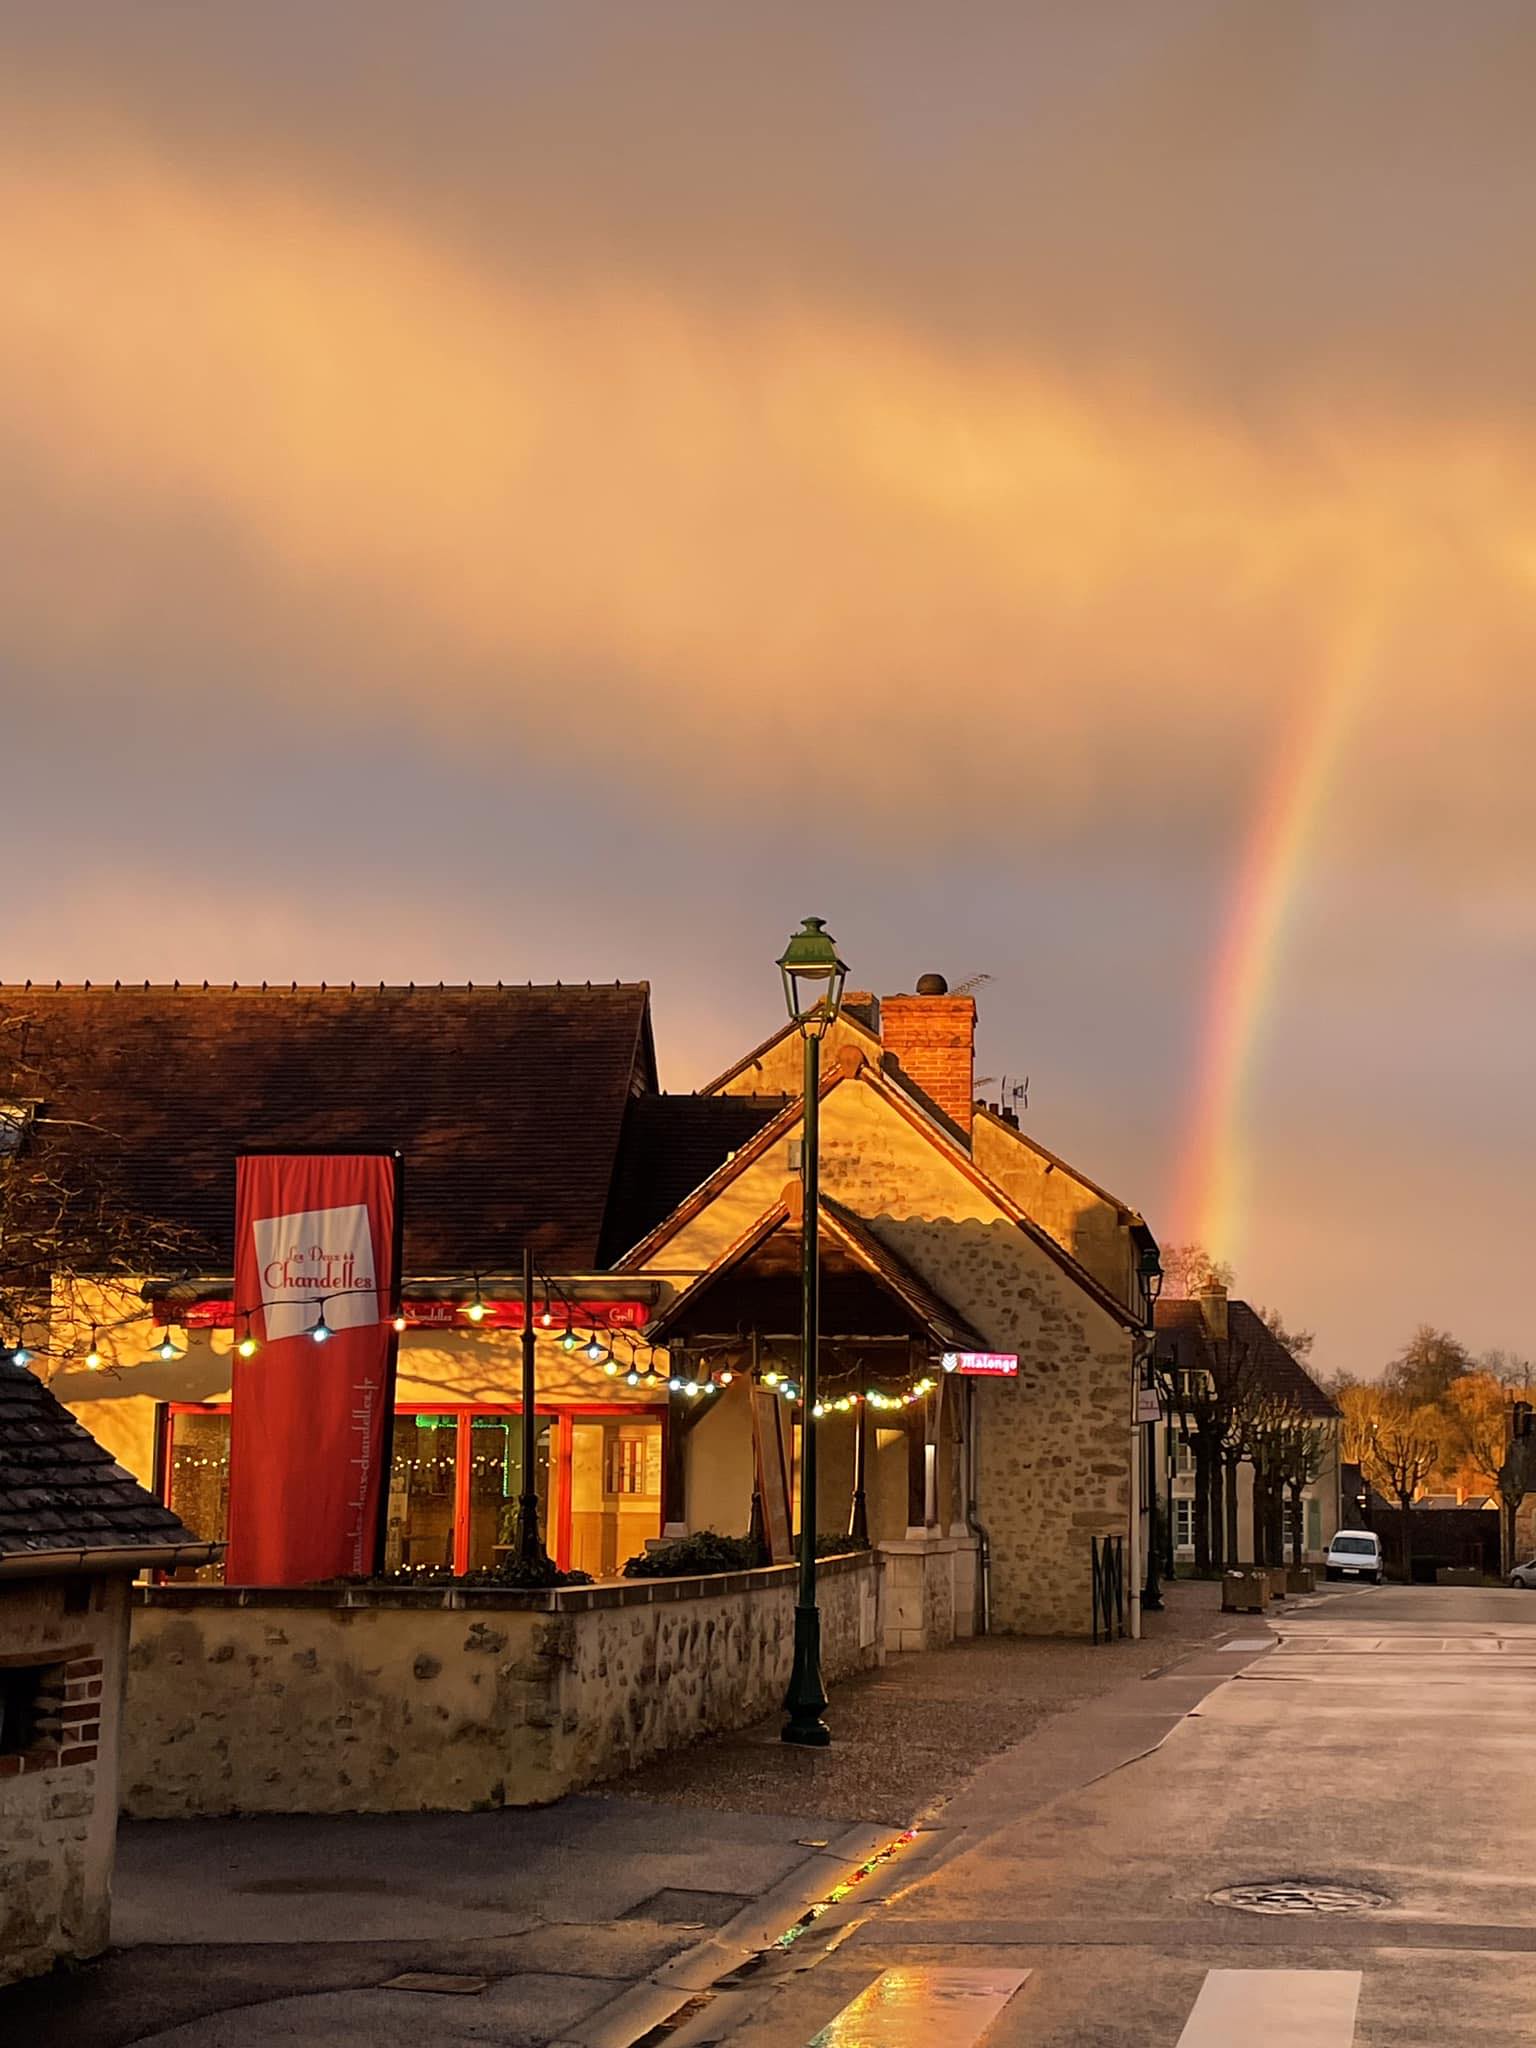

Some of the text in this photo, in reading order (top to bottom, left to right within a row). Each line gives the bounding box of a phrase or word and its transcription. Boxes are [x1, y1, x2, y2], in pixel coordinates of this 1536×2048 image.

[288, 1246, 340, 1263] Les Deux
[264, 1261, 373, 1289] Chandelles
[960, 1354, 1017, 1373] Malongo
